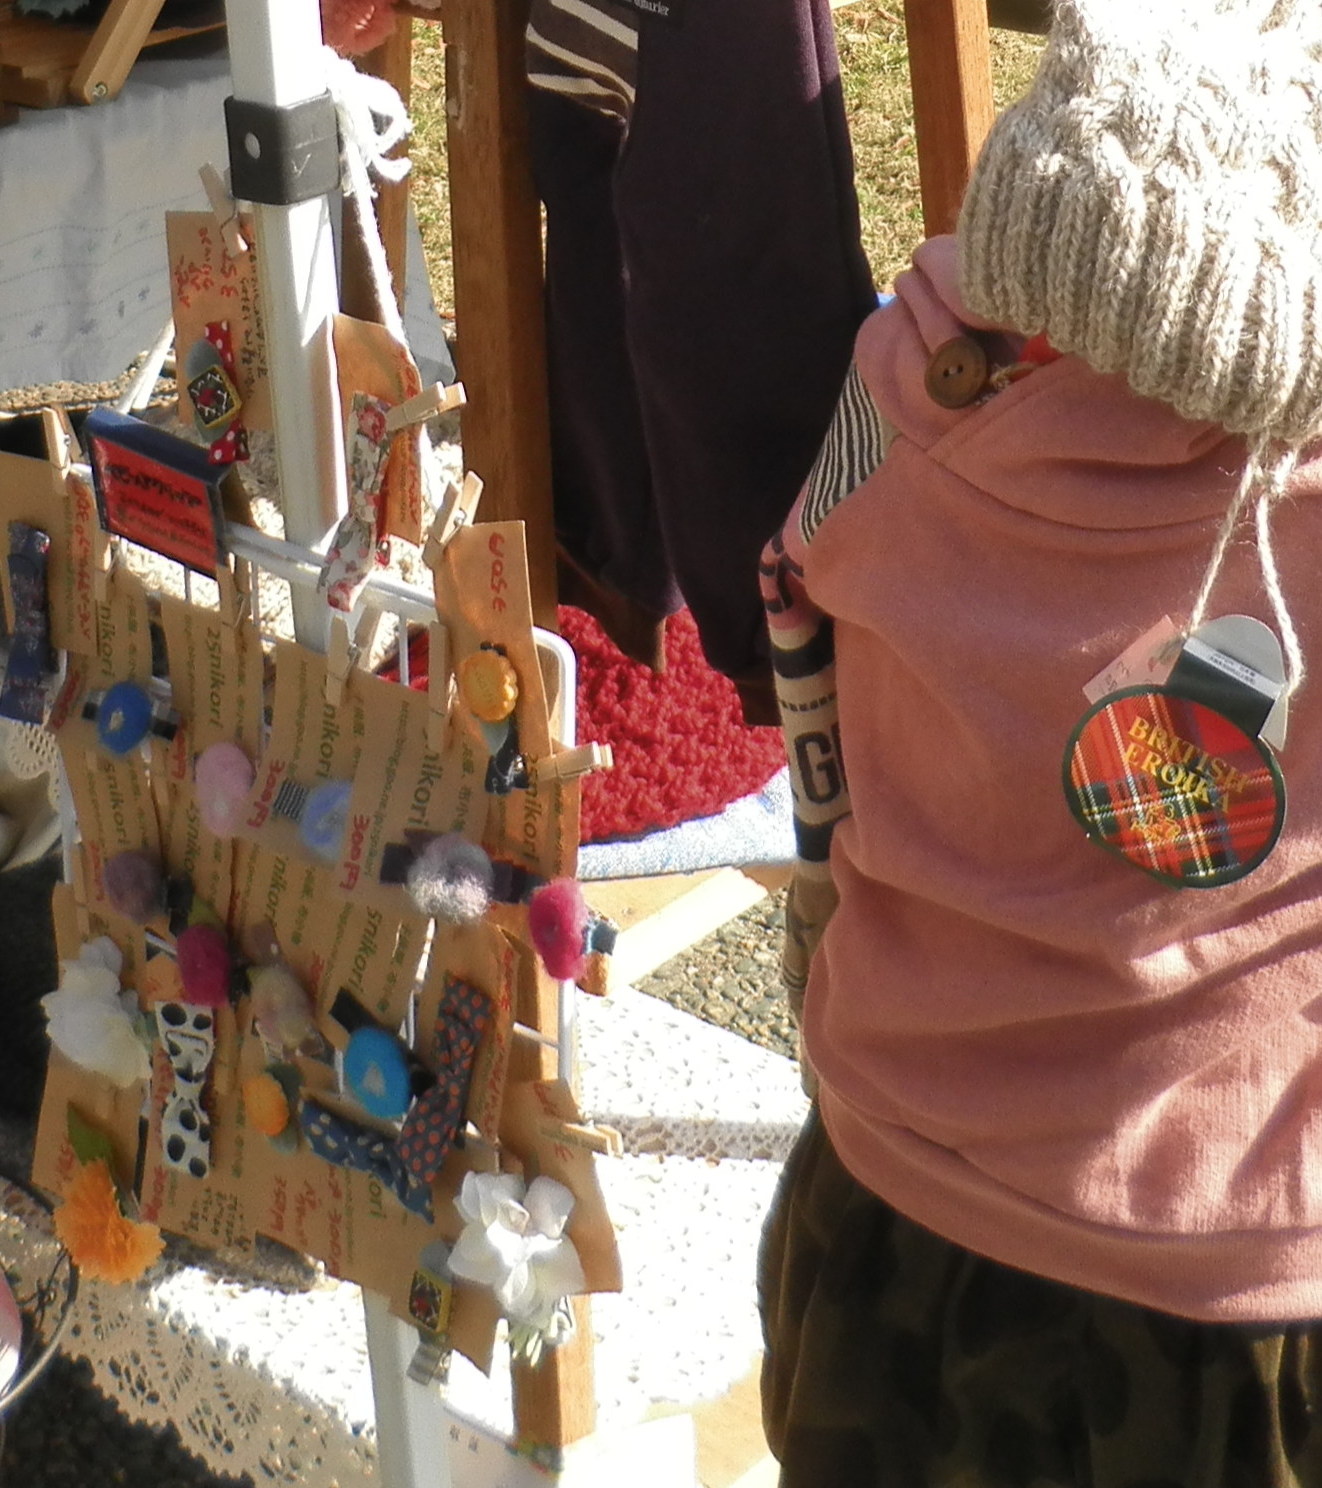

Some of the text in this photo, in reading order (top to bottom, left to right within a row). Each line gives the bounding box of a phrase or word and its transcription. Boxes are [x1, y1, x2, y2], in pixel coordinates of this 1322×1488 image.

[206, 626, 226, 729] 25nikori
[246, 761, 285, 828] 300円
[1124, 742, 1231, 814] EROIKA
[1127, 715, 1250, 795] BRITISH
[104, 762, 130, 845] 5nikori
[339, 814, 370, 891] 300円
[348, 905, 383, 993] 5nikori
